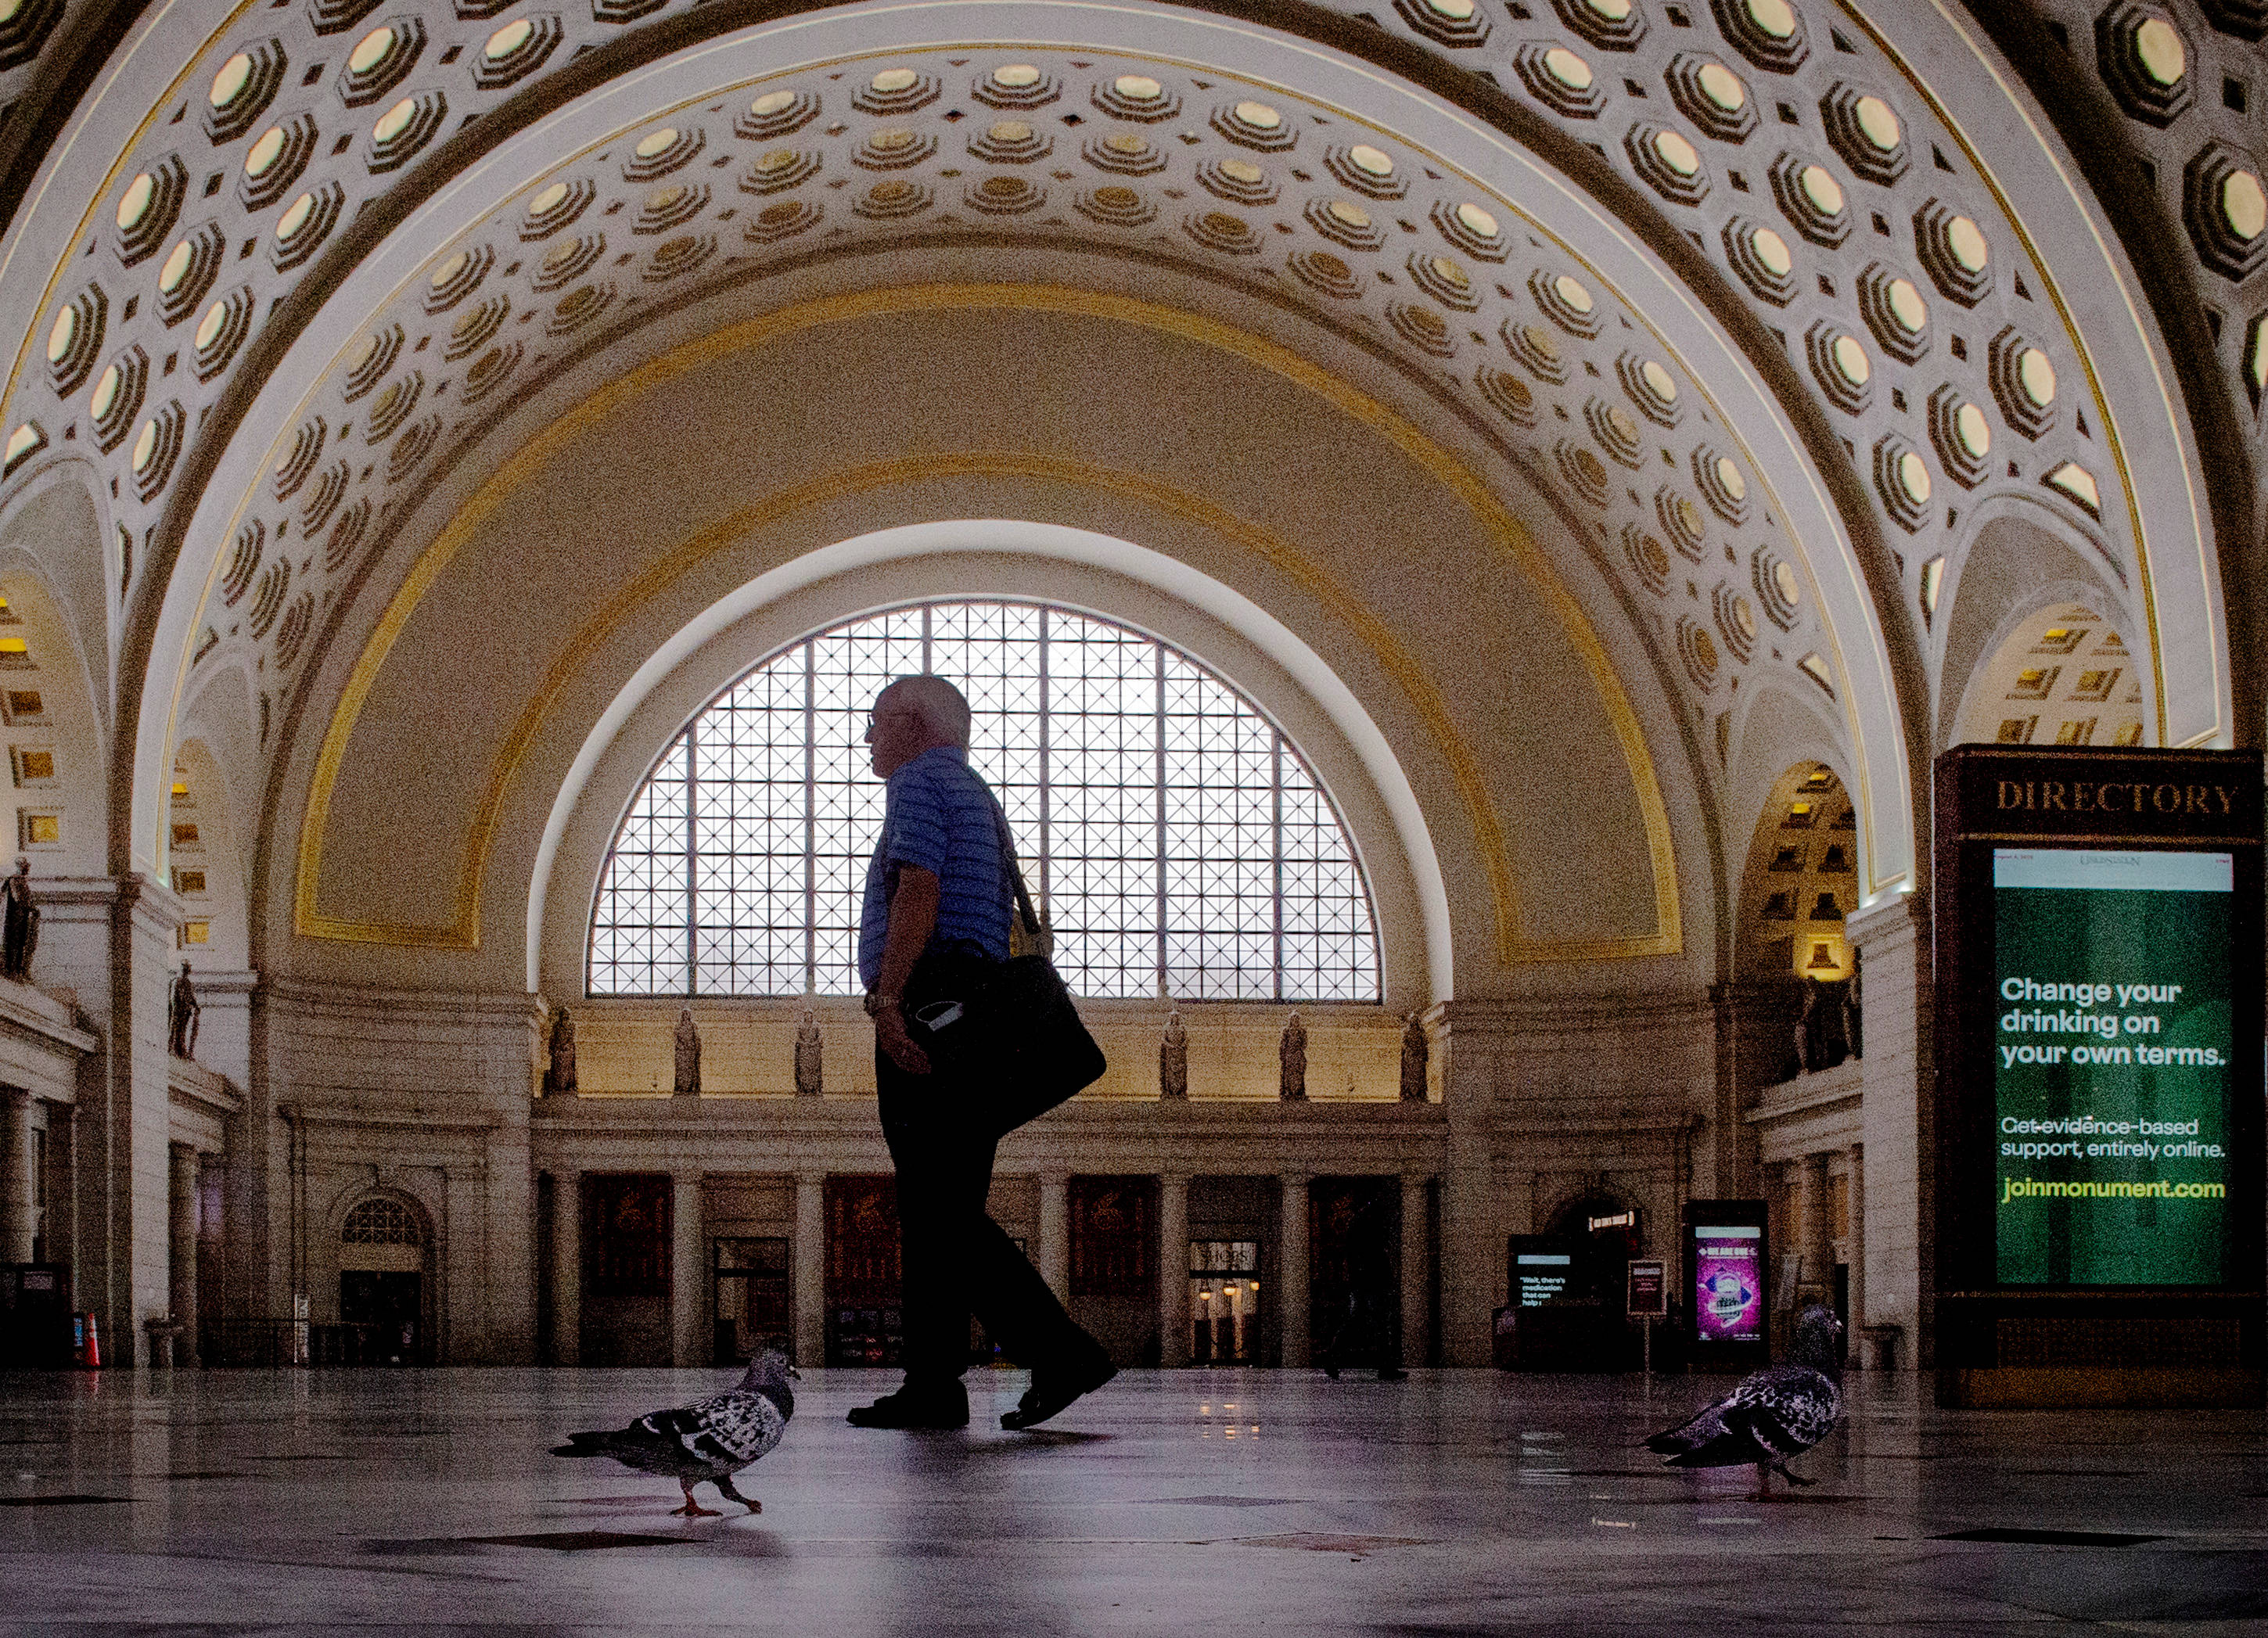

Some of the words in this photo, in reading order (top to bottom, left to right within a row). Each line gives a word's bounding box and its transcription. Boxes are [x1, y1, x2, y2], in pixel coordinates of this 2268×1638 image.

[1997, 781, 2238, 814] DIRECTORY
[2000, 977, 2112, 1008] Change
[2115, 982, 2184, 1008] your
[2000, 1008, 2119, 1039] drinking
[2123, 1016, 2160, 1034] on
[2000, 1044, 2068, 1069] your
[2071, 1046, 2131, 1065] own
[2135, 1044, 2227, 1065] terms.
[2001, 1116, 2038, 1134] Get
[2041, 1116, 2199, 1135] evidence-based
[2000, 1140, 2083, 1159] support,
[2086, 1140, 2159, 1162] entirely
[2162, 1140, 2226, 1158] online.
[2001, 1176, 2227, 1204] joinmonument.com
